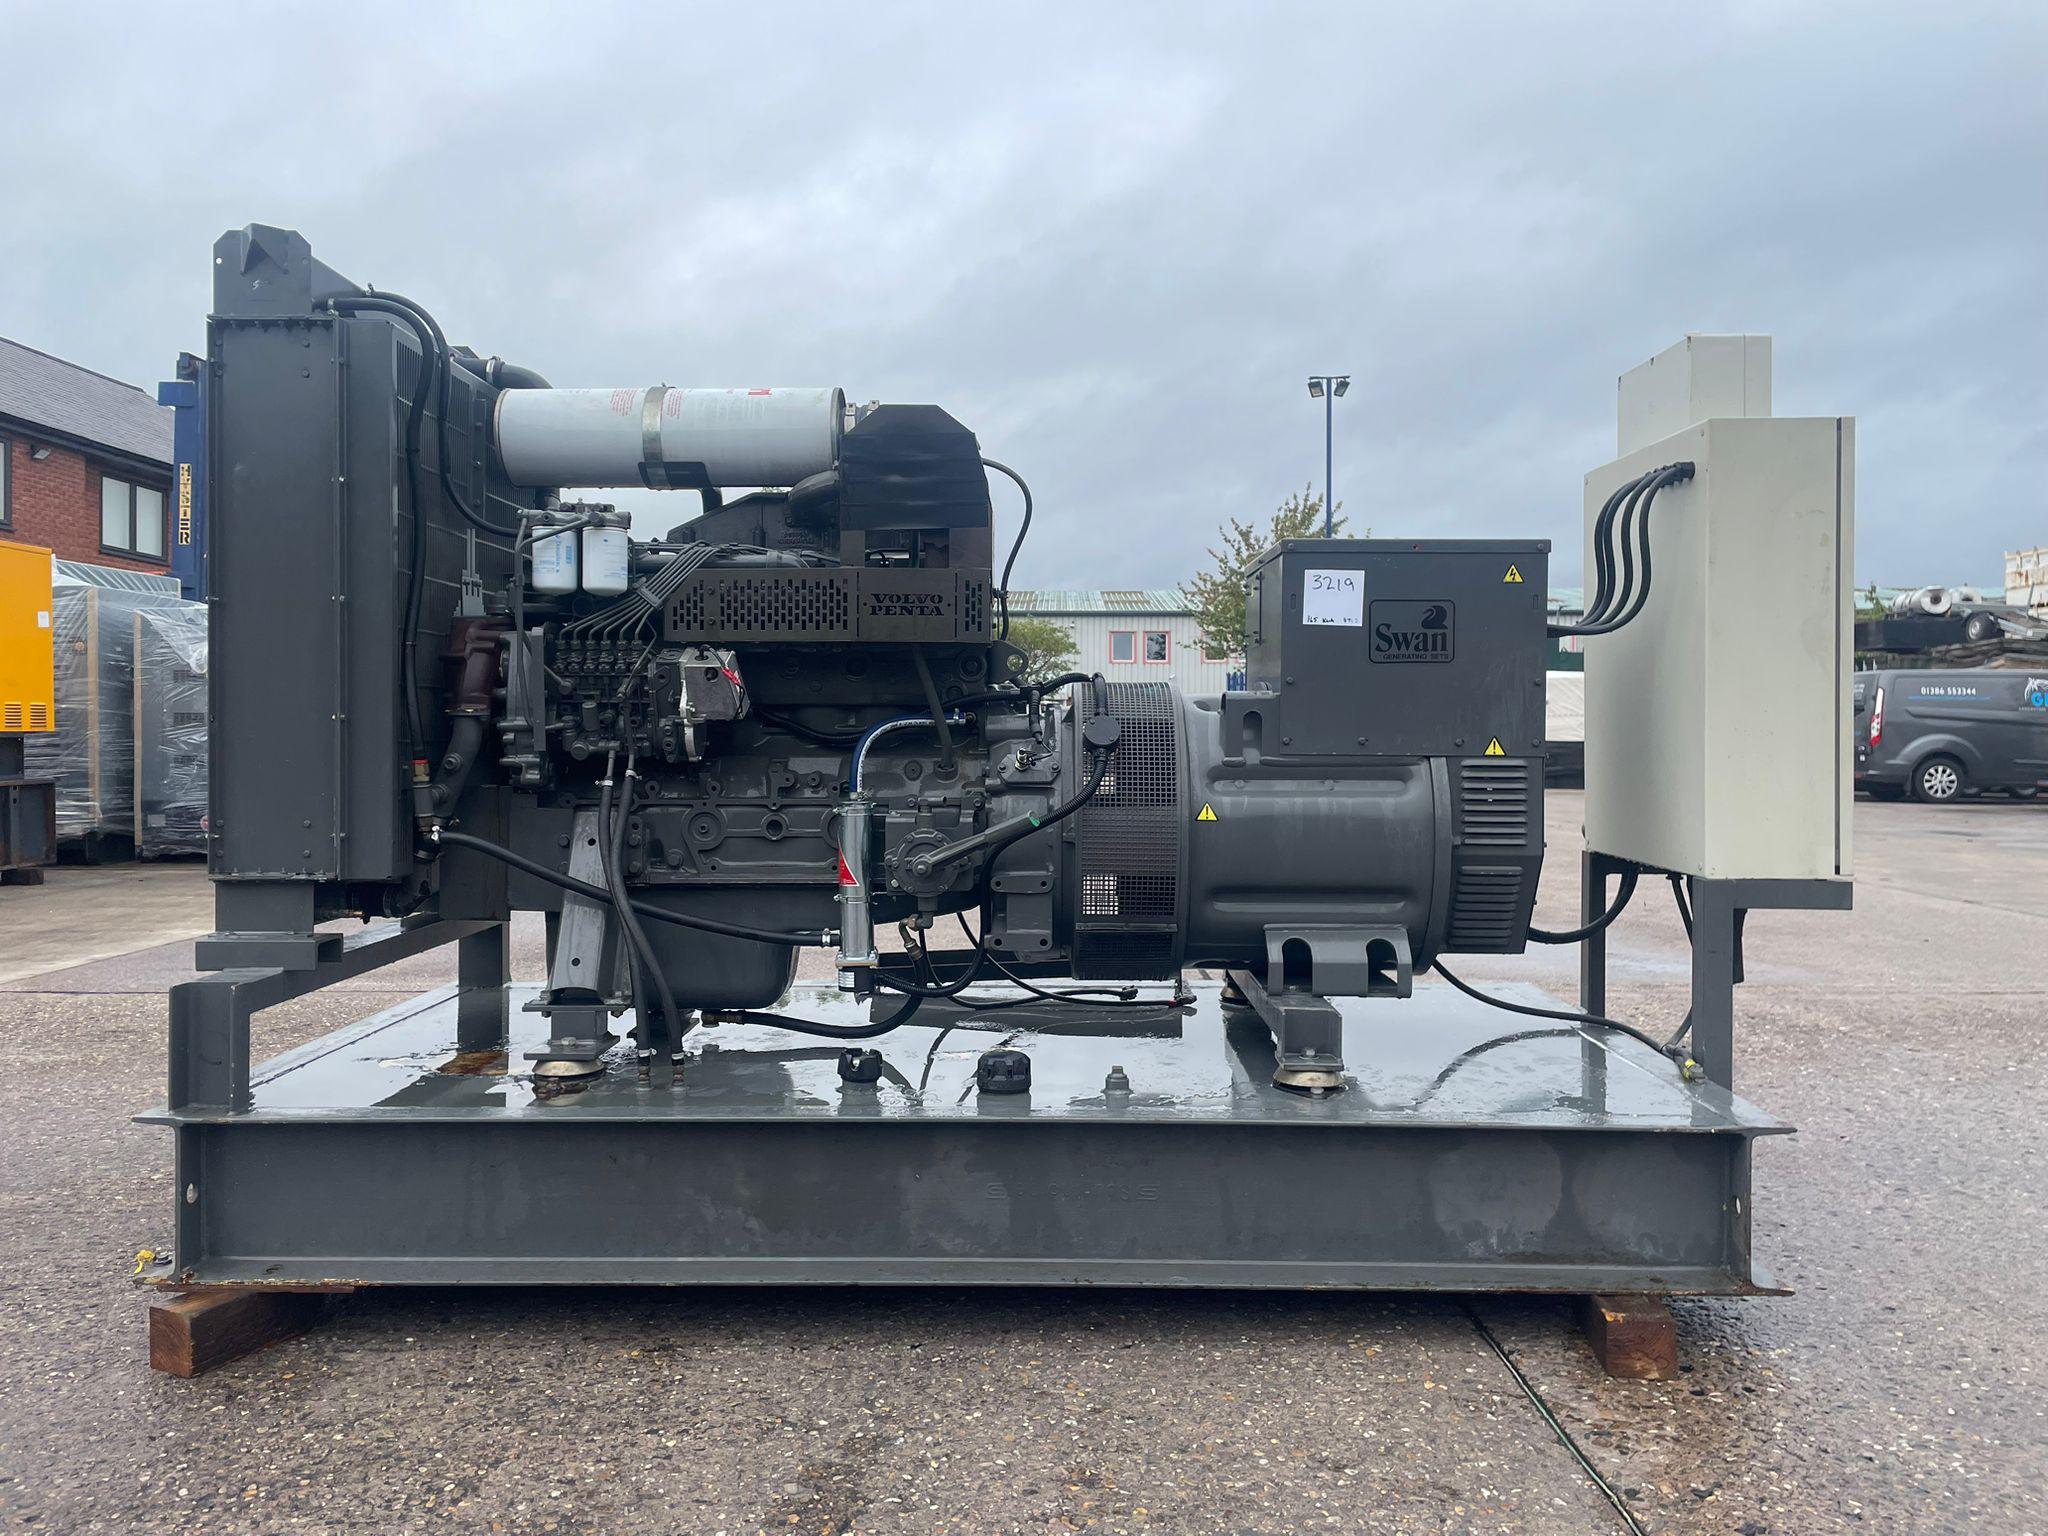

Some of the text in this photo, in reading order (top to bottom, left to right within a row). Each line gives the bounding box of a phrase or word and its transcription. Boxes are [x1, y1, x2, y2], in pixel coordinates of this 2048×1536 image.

[1311, 574, 1355, 592] 3219
[870, 593, 944, 604] VOLVO
[869, 605, 945, 616] PENTA
[1375, 623, 1449, 653] Swan
